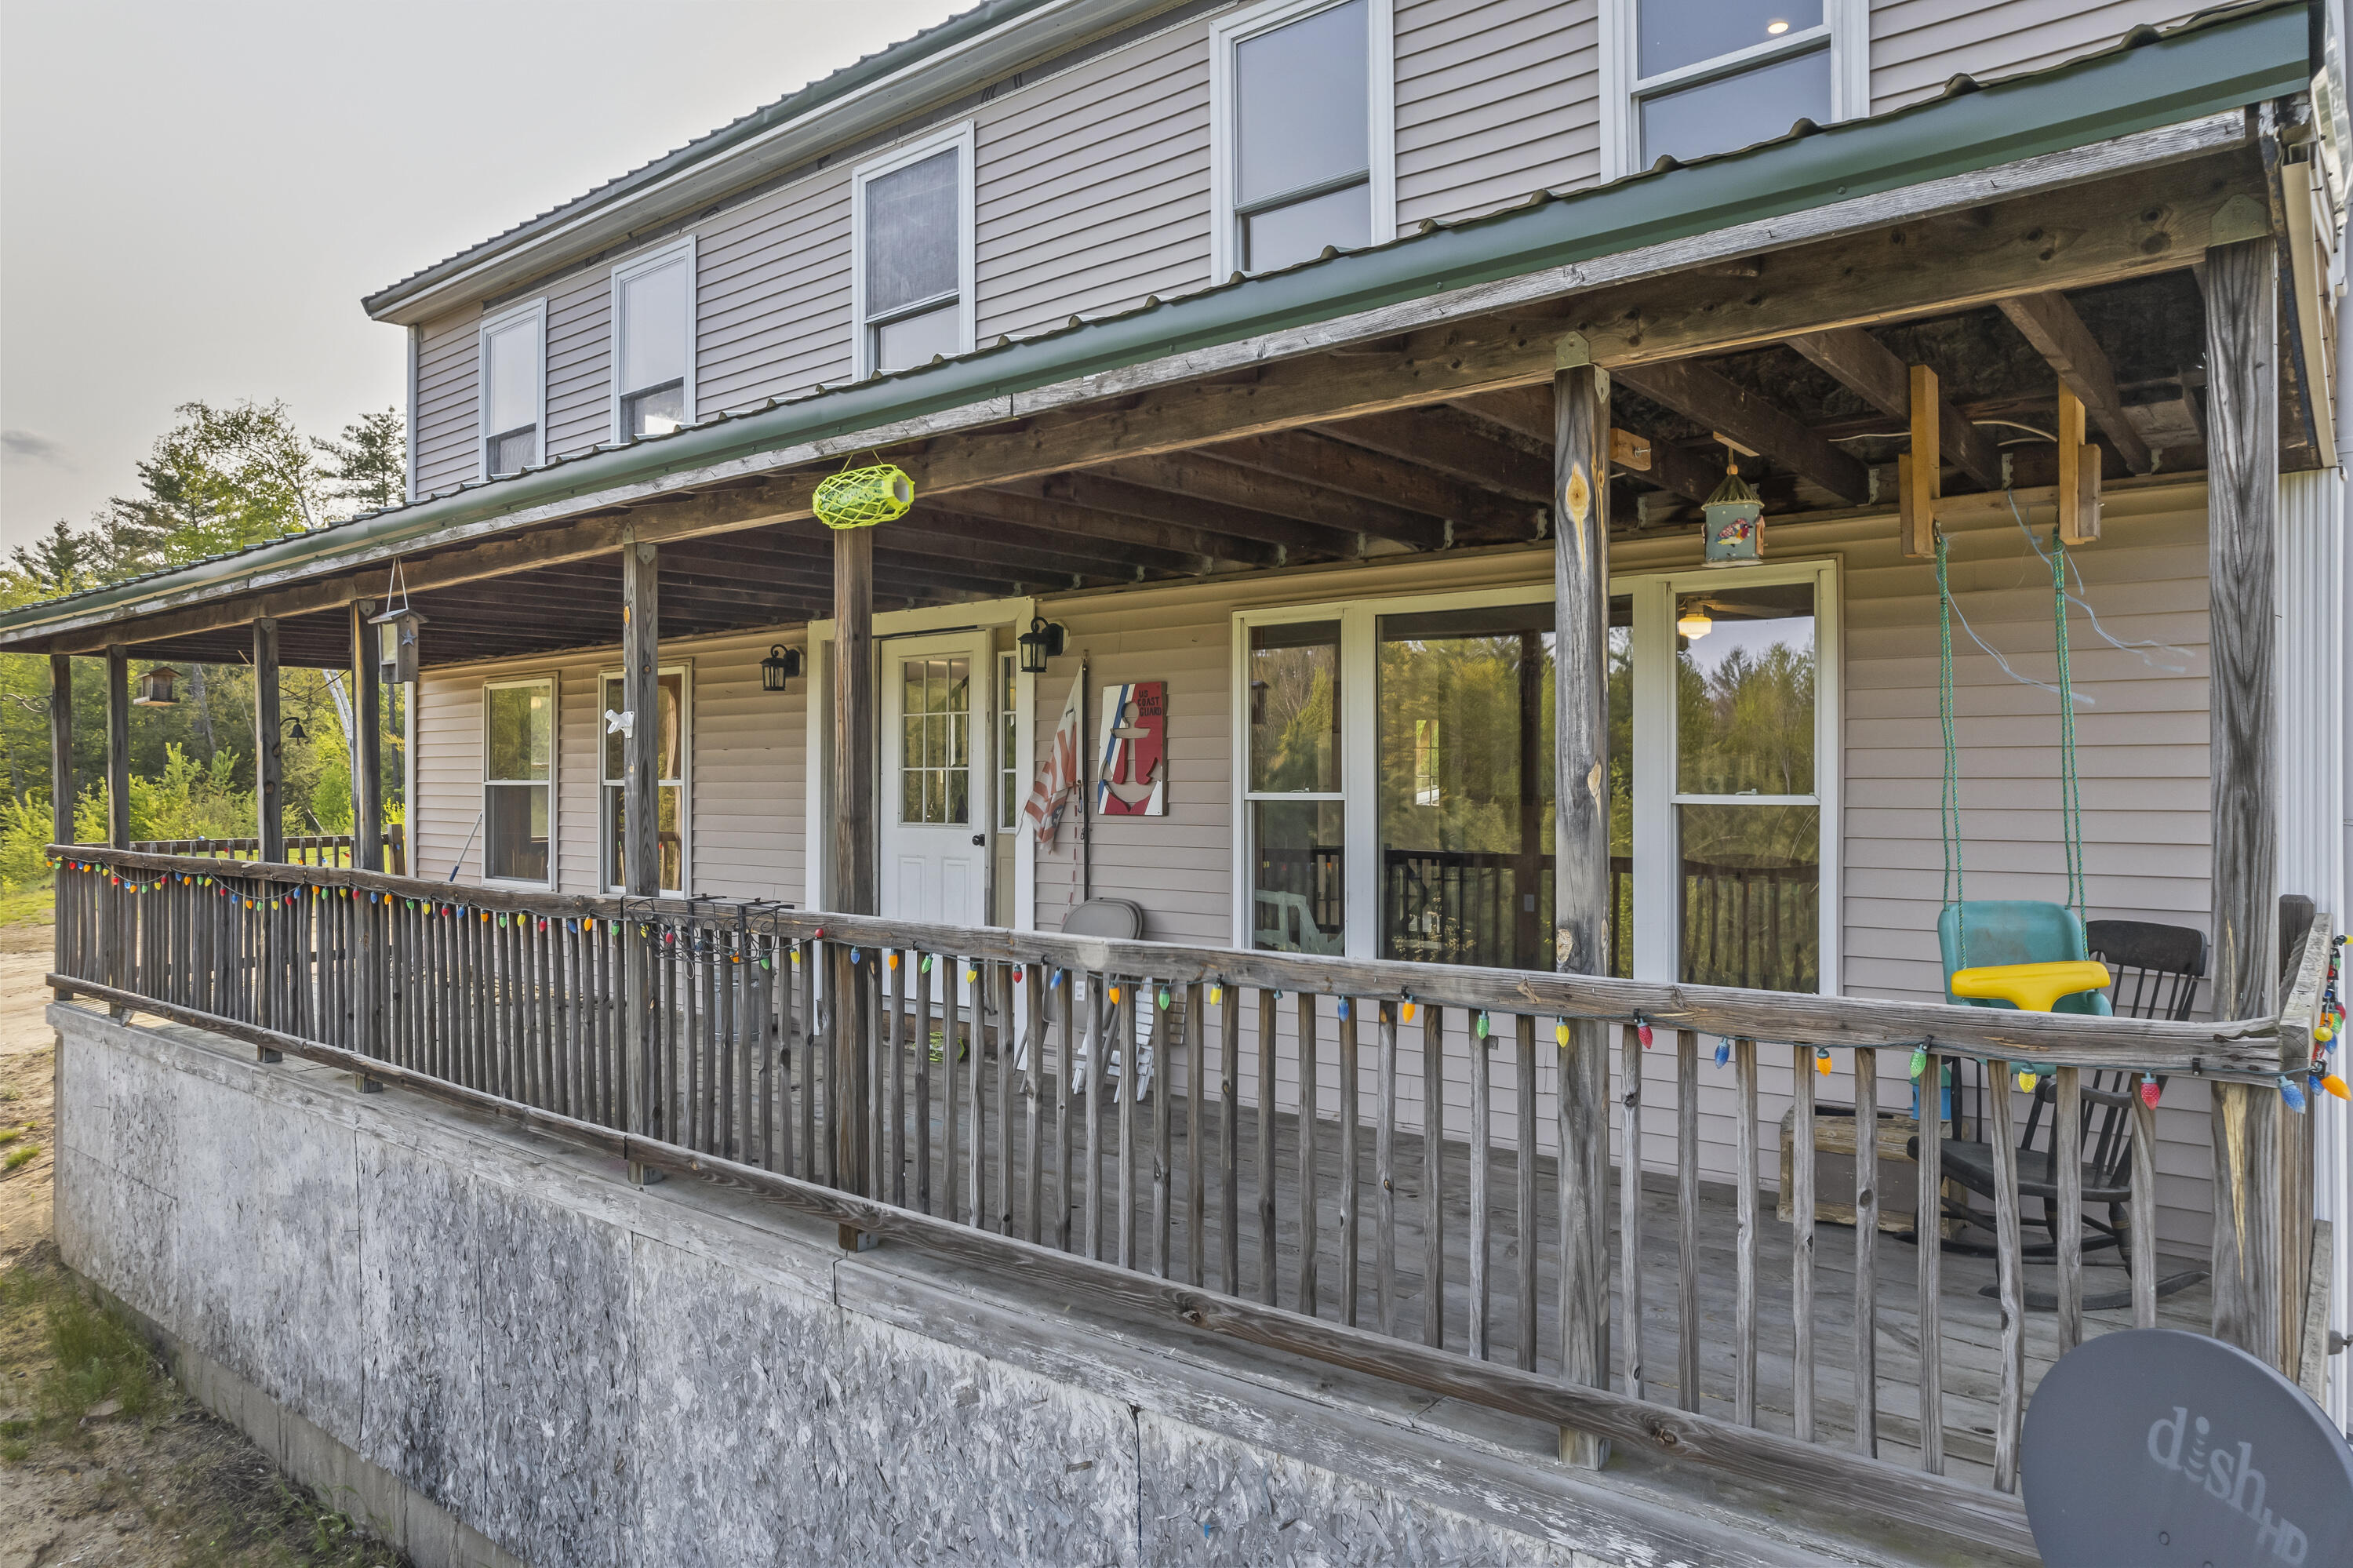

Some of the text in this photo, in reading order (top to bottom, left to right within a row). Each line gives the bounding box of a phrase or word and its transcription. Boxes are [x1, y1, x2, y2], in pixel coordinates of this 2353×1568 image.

[1137, 697, 1159, 706] COAST
[1140, 707, 1162, 716] GUARD
[2148, 1406, 2266, 1525] dish
